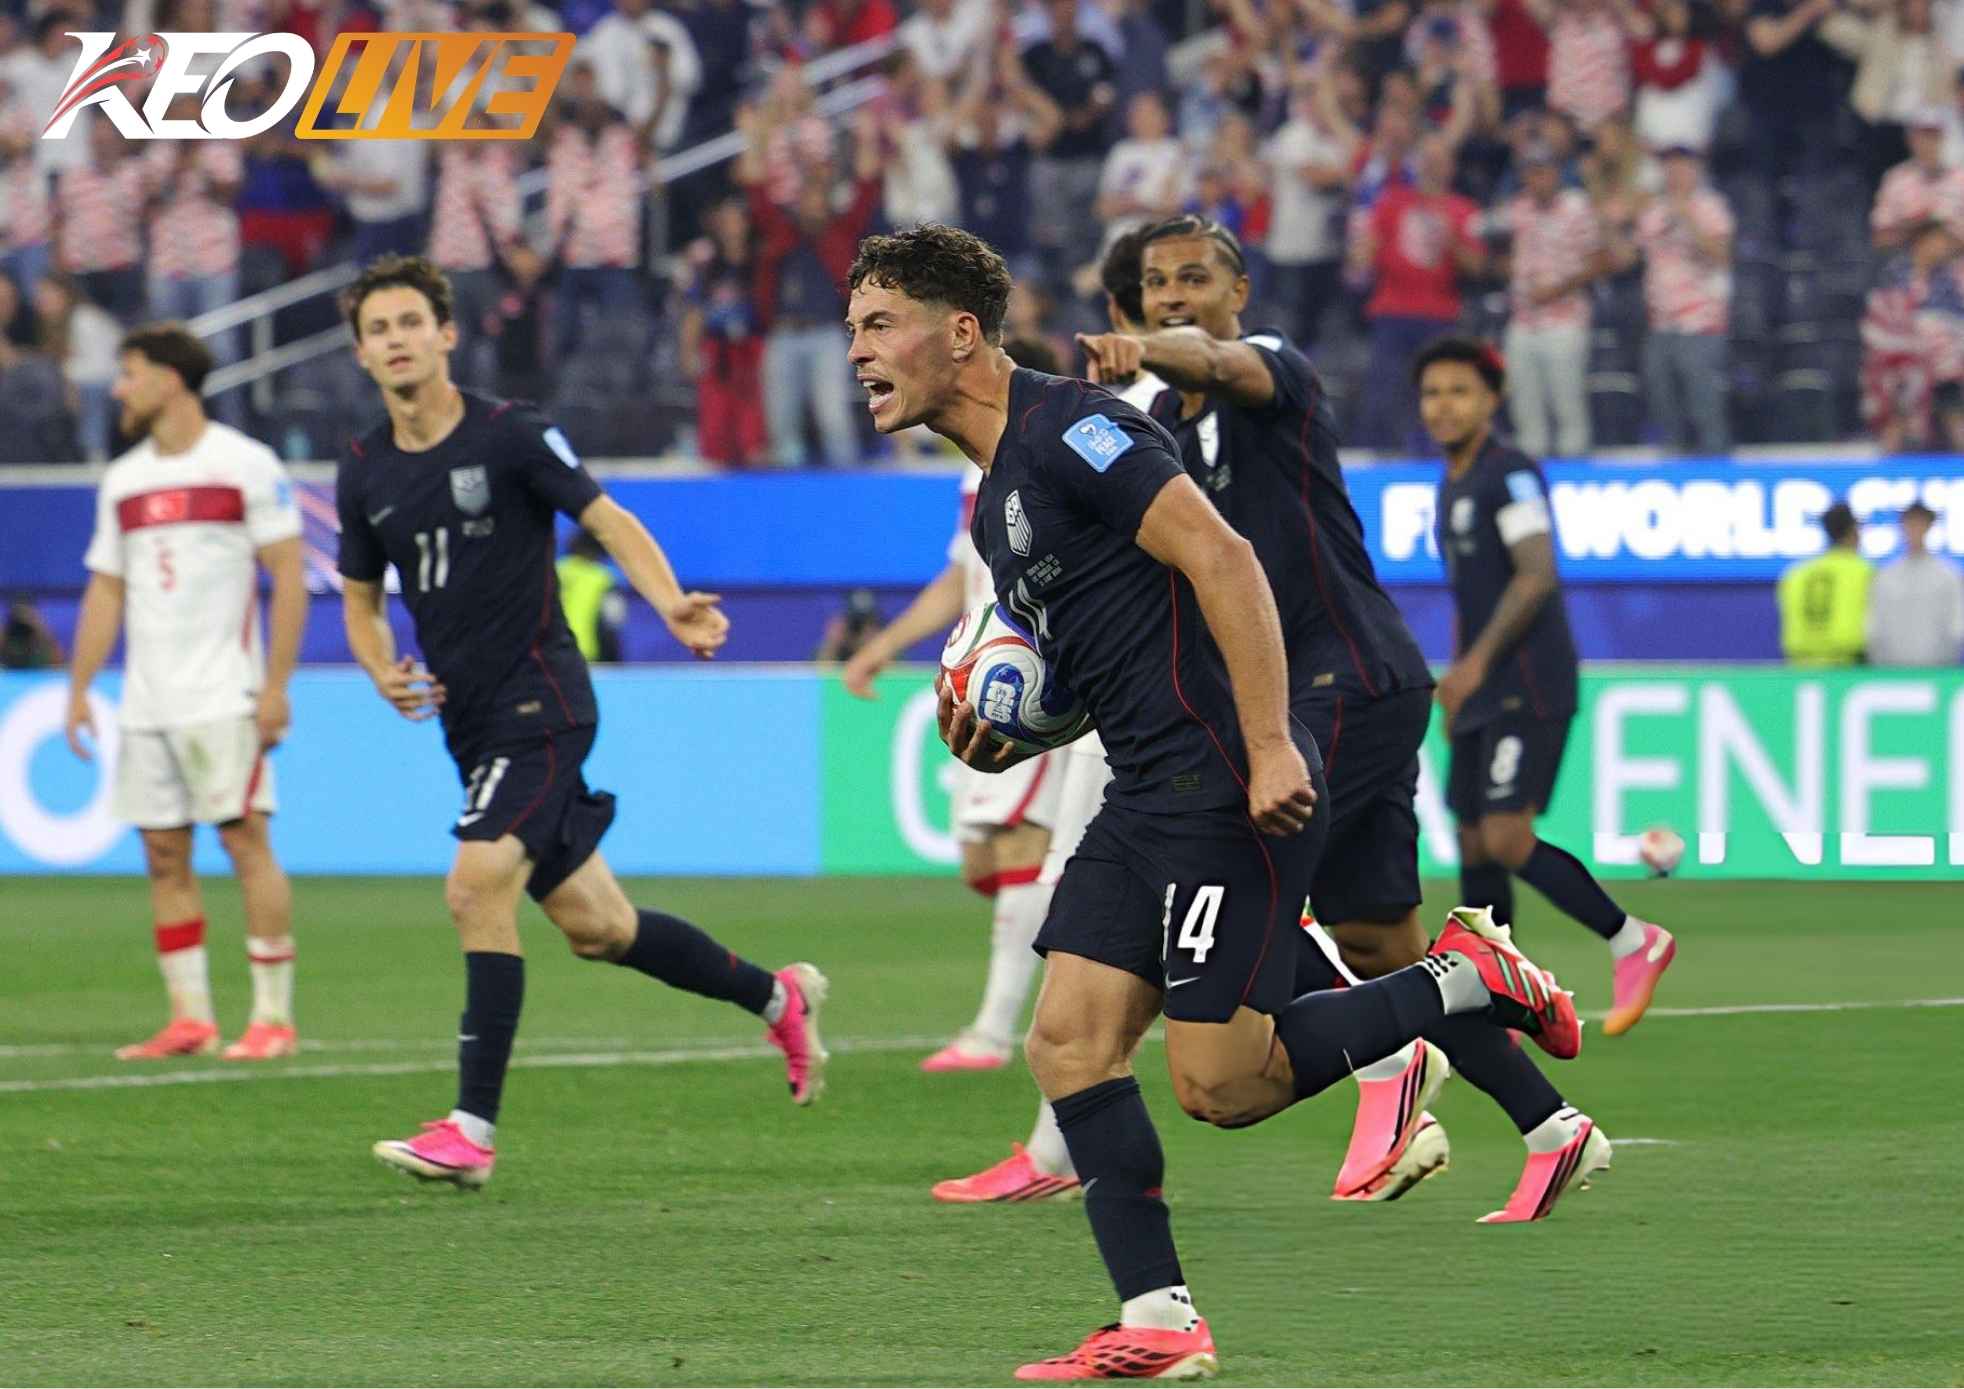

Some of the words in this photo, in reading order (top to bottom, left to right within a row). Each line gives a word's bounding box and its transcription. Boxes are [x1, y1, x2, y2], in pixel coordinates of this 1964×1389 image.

[415, 526, 449, 592] 11
[1551, 479, 1833, 560] WORLD
[1489, 735, 1523, 784] 8
[1592, 683, 1964, 866] ENE
[1162, 882, 1225, 963] 14
